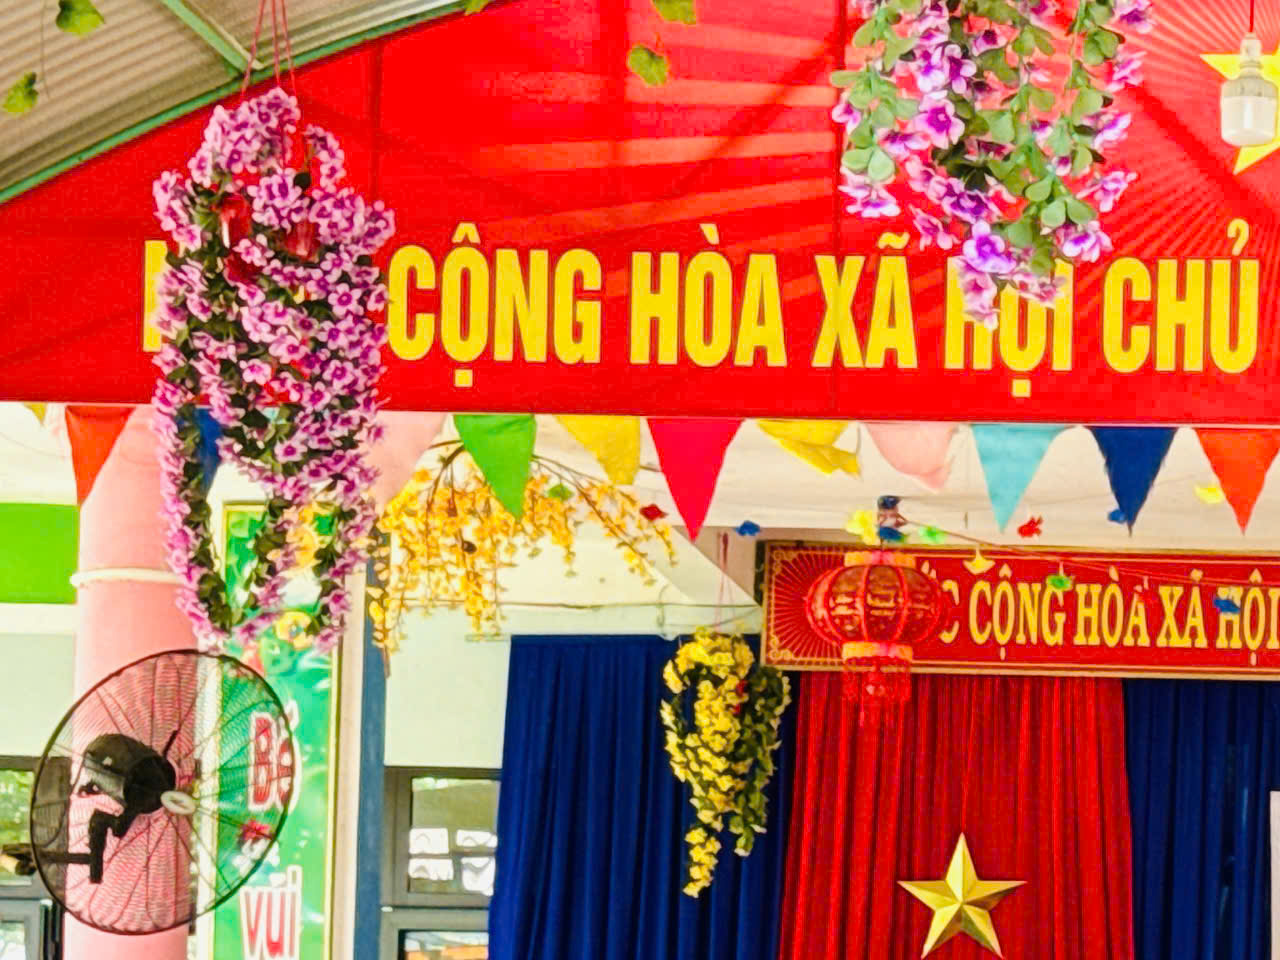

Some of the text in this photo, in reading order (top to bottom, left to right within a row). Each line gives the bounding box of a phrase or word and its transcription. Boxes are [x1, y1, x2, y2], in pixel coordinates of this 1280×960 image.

[387, 223, 601, 387] CỘNG
[630, 224, 787, 367] HÒA
[812, 231, 917, 369] XÃ
[1103, 218, 1258, 374] CHỦ
[969, 563, 1067, 660] CỘNG
[1073, 565, 1150, 648] HÒA
[243, 868, 299, 958] vui
